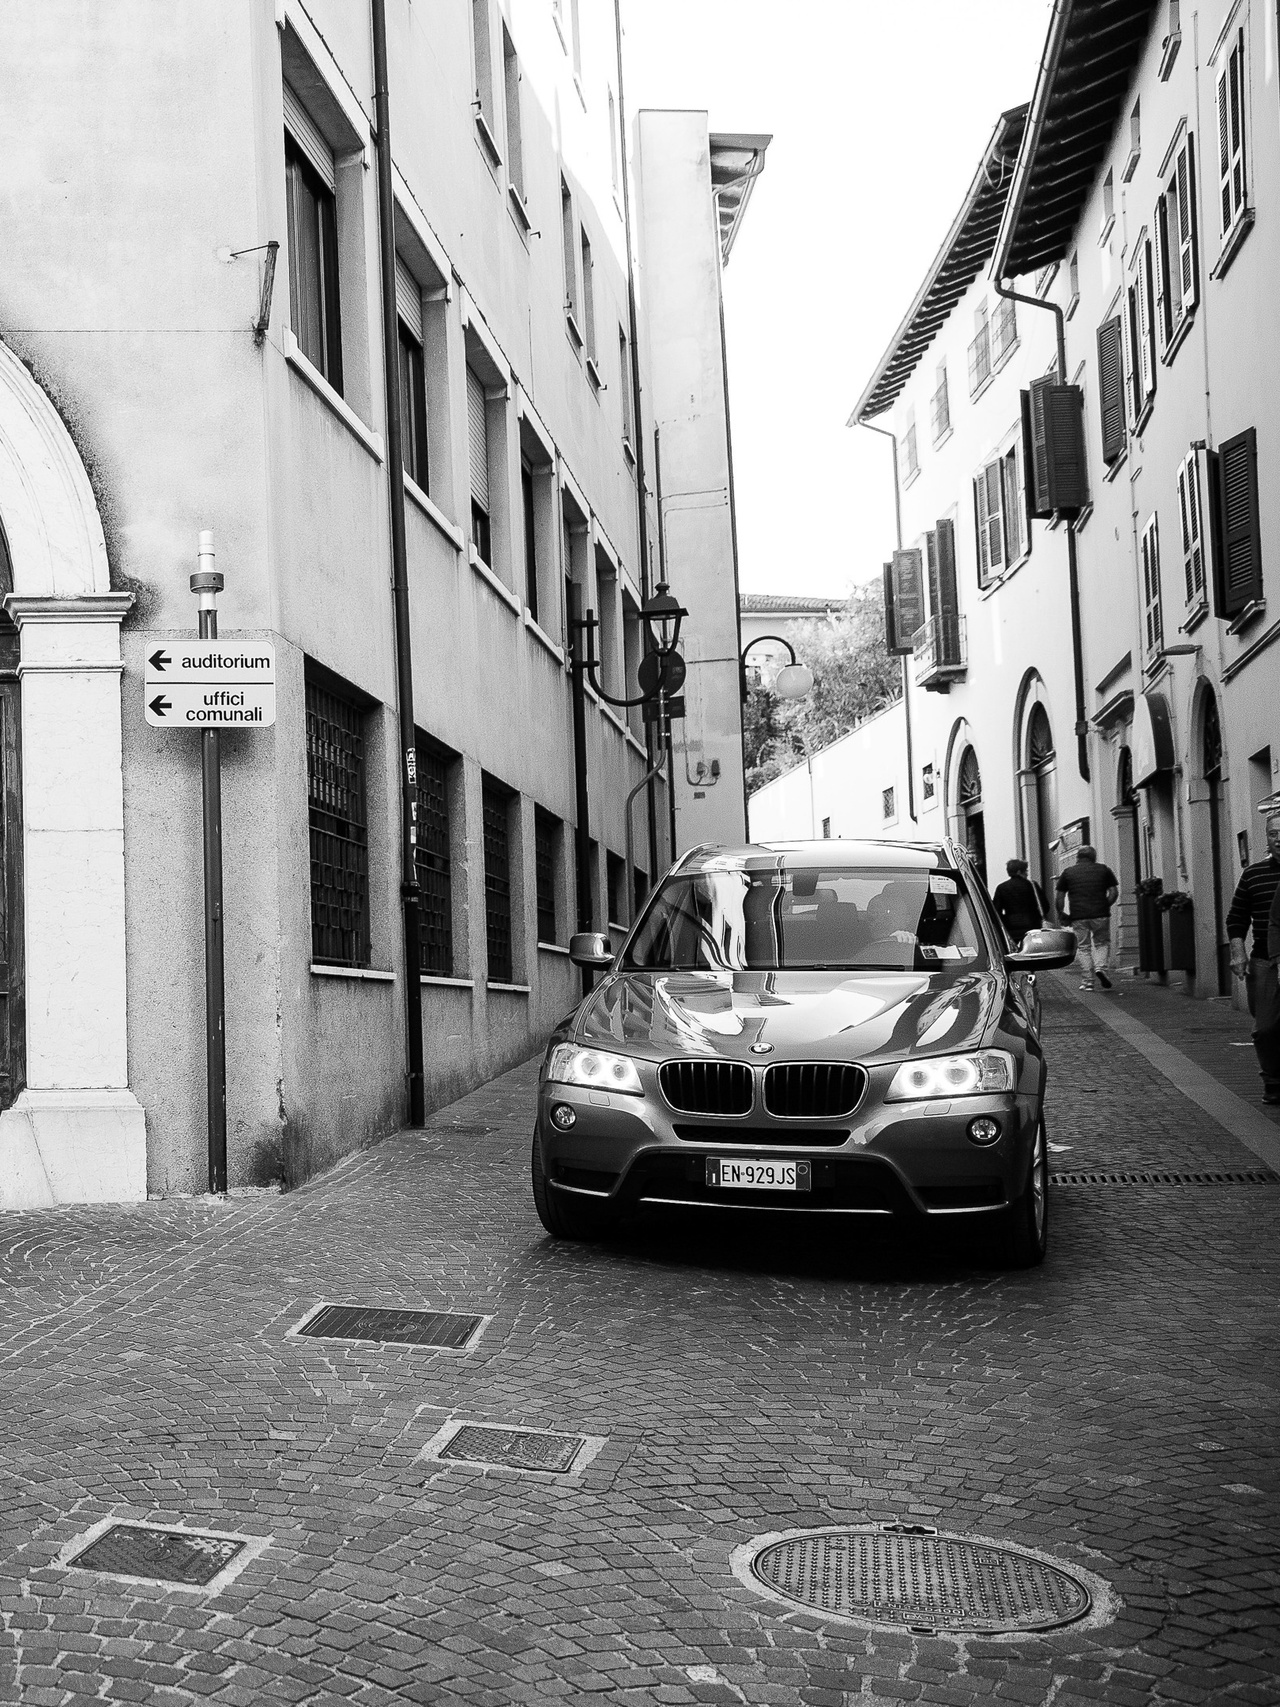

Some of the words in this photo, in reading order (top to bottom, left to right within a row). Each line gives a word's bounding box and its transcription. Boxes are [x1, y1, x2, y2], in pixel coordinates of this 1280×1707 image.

[181, 654, 270, 669] auditorium
[204, 691, 244, 705] uffici
[186, 707, 263, 722] comunali
